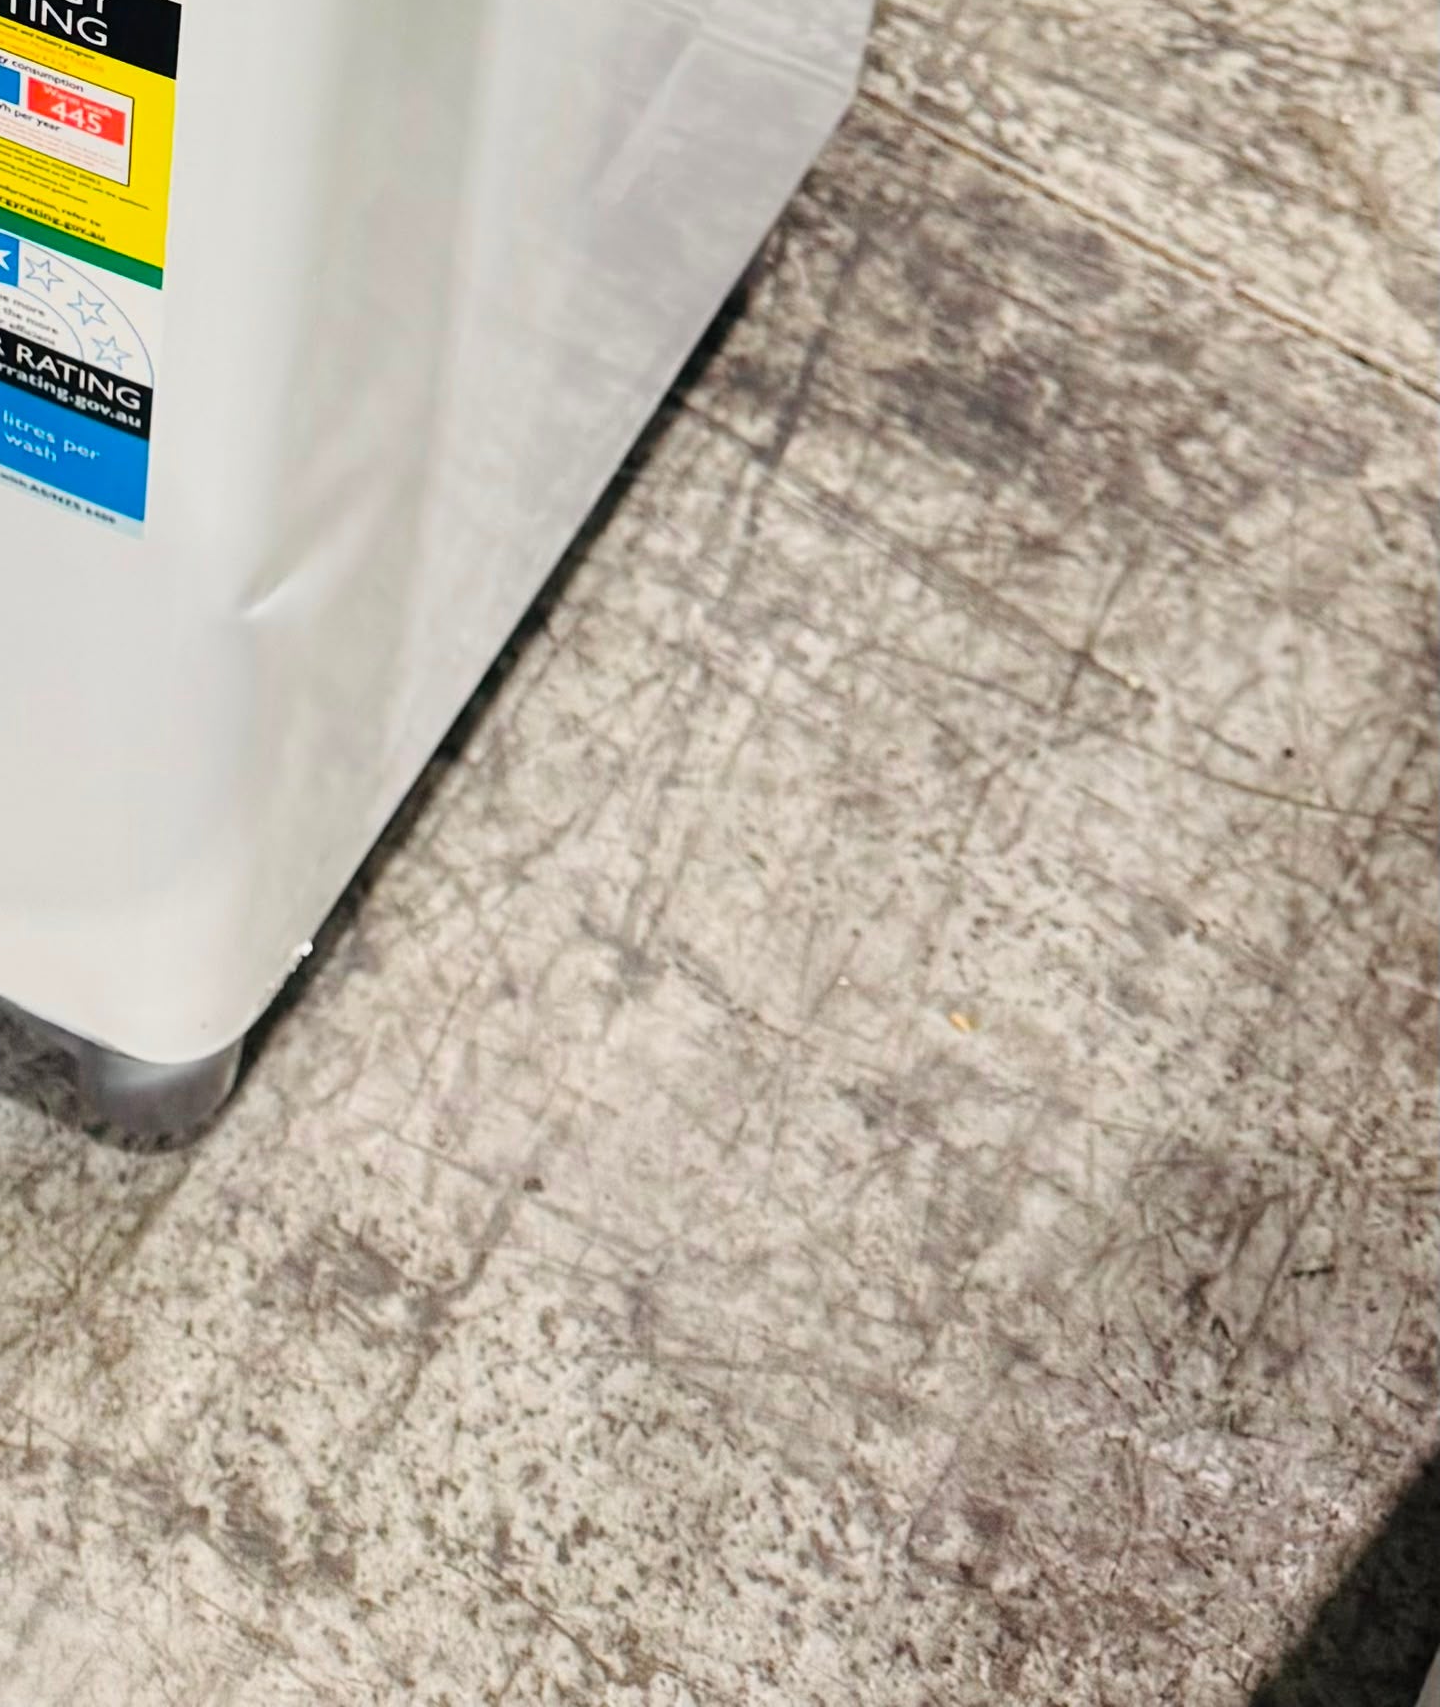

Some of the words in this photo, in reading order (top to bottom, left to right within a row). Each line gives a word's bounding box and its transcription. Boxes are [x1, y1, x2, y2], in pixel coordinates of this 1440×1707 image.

[11, 60, 85, 93] consumption
[42, 84, 80, 106] Warm
[14, 107, 35, 121] per
[36, 116, 62, 133] year
[50, 101, 103, 135] 445
[3, 307, 22, 319] the
[26, 317, 58, 334] more
[13, 299, 45, 317] more
[15, 342, 142, 411] RATING
[2, 409, 56, 444] litres
[63, 437, 101, 460] per
[3, 431, 58, 463] wash
